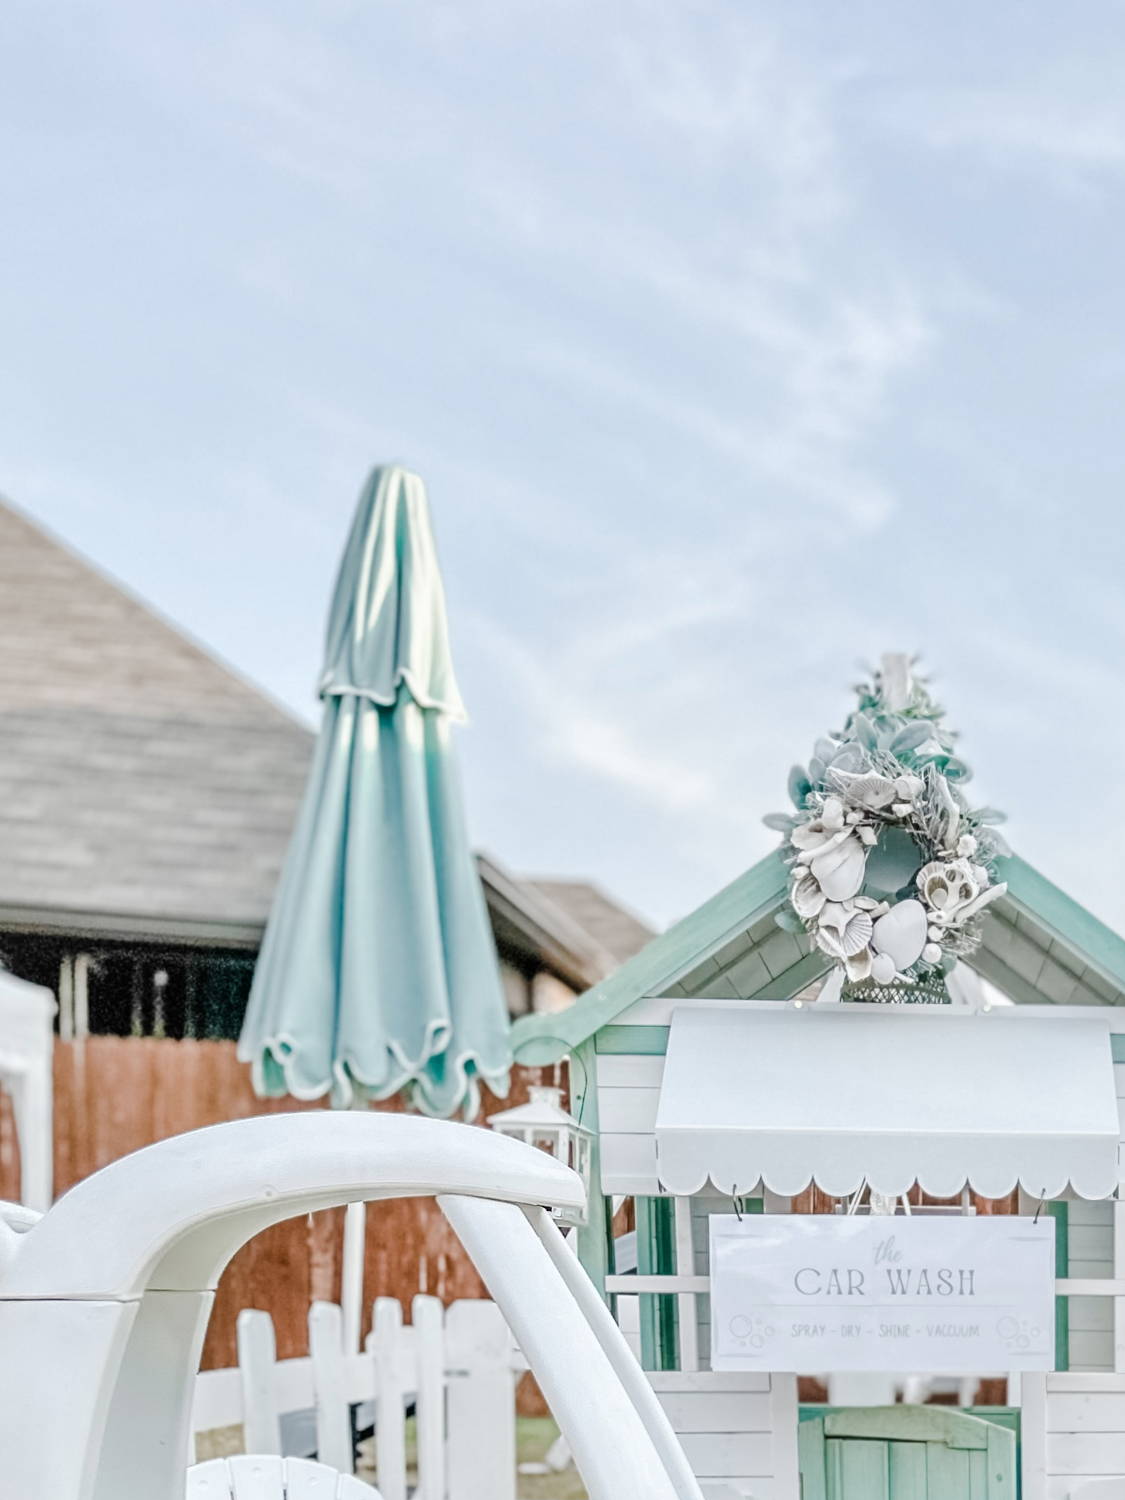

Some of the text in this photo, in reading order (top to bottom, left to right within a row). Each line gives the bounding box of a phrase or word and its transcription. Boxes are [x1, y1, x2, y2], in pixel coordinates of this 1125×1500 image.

[873, 1234, 903, 1265] the
[794, 1268, 976, 1296] CAR WASH
[791, 1324, 826, 1338] SPRAY
[840, 1324, 862, 1338] DRY
[879, 1324, 911, 1338] SHINE
